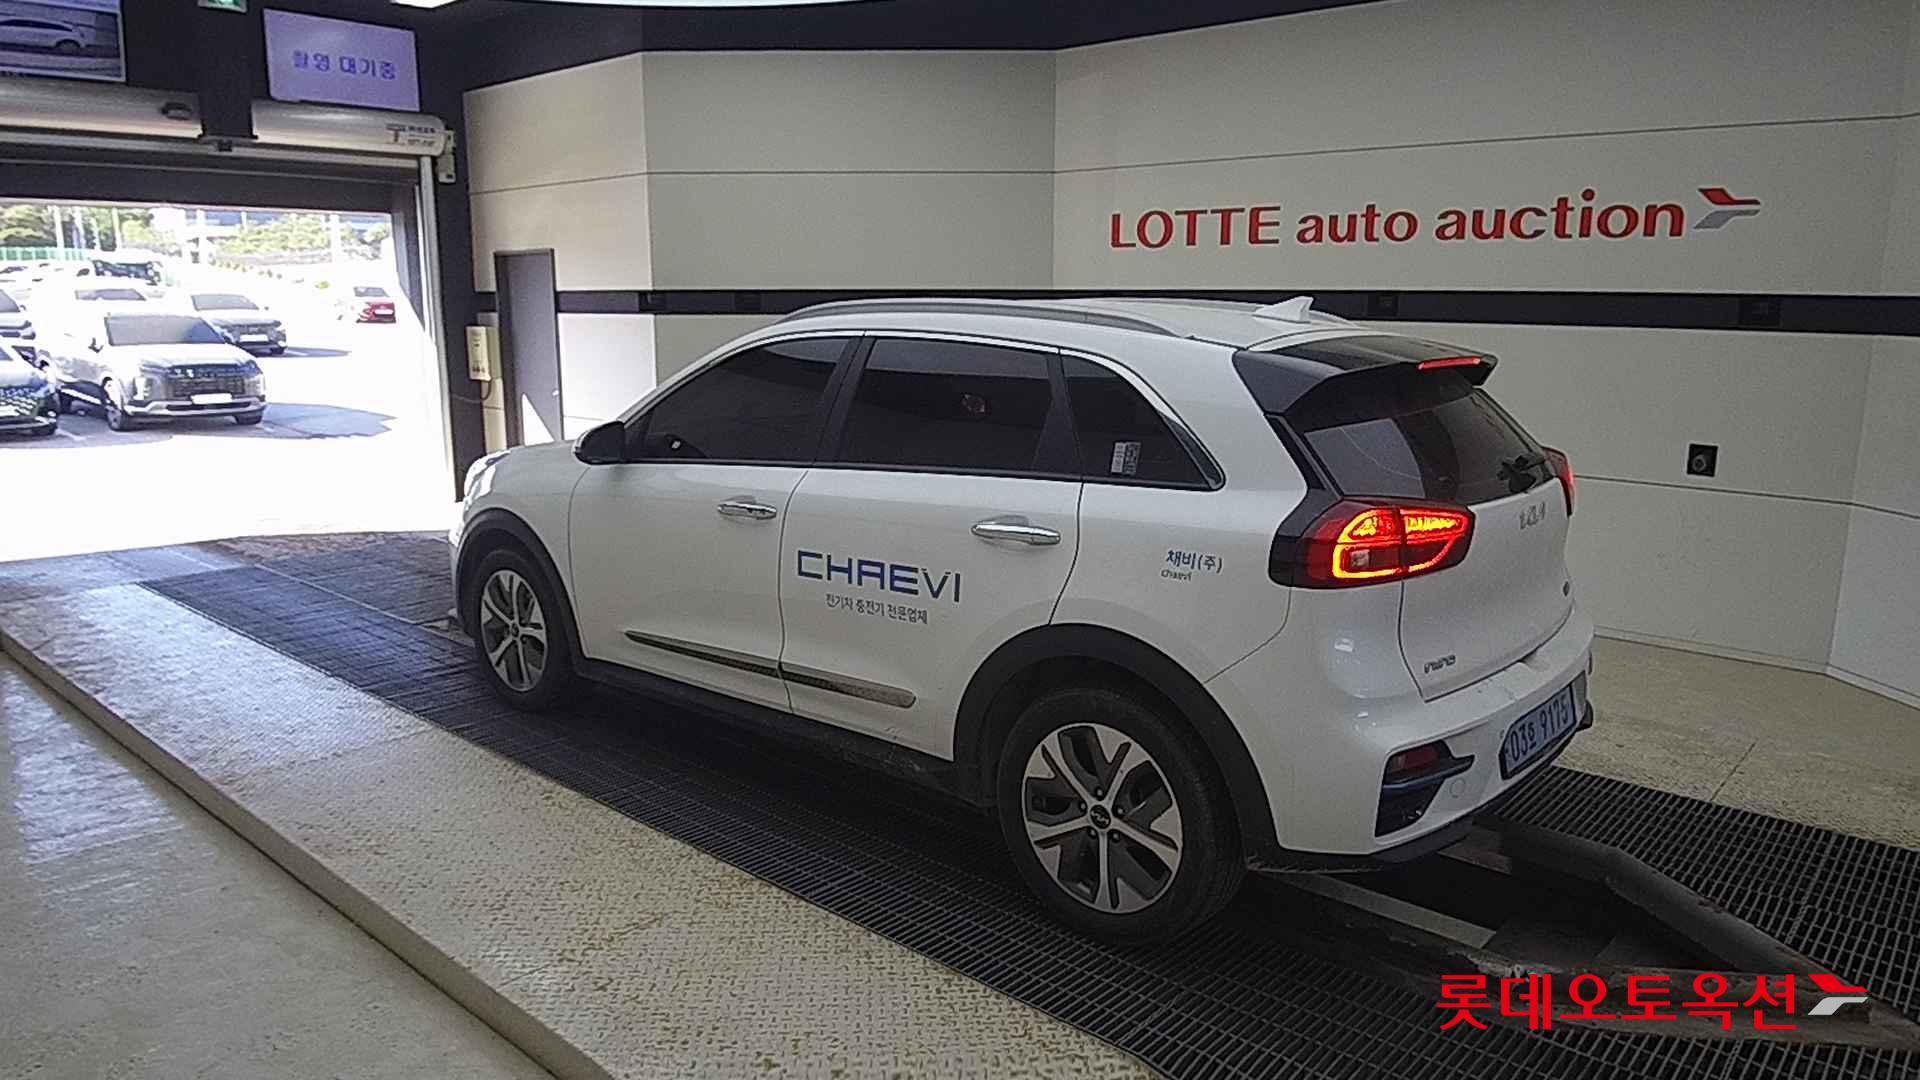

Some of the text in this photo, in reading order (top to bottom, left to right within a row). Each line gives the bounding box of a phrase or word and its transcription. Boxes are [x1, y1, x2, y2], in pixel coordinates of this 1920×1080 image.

[339, 56, 396, 80] 대기중
[1110, 189, 1686, 249] LOTTE auto auction
[797, 549, 961, 603] CHAEVI
[1166, 550, 1222, 574] 채비(주)
[1540, 693, 1569, 741] 9175
